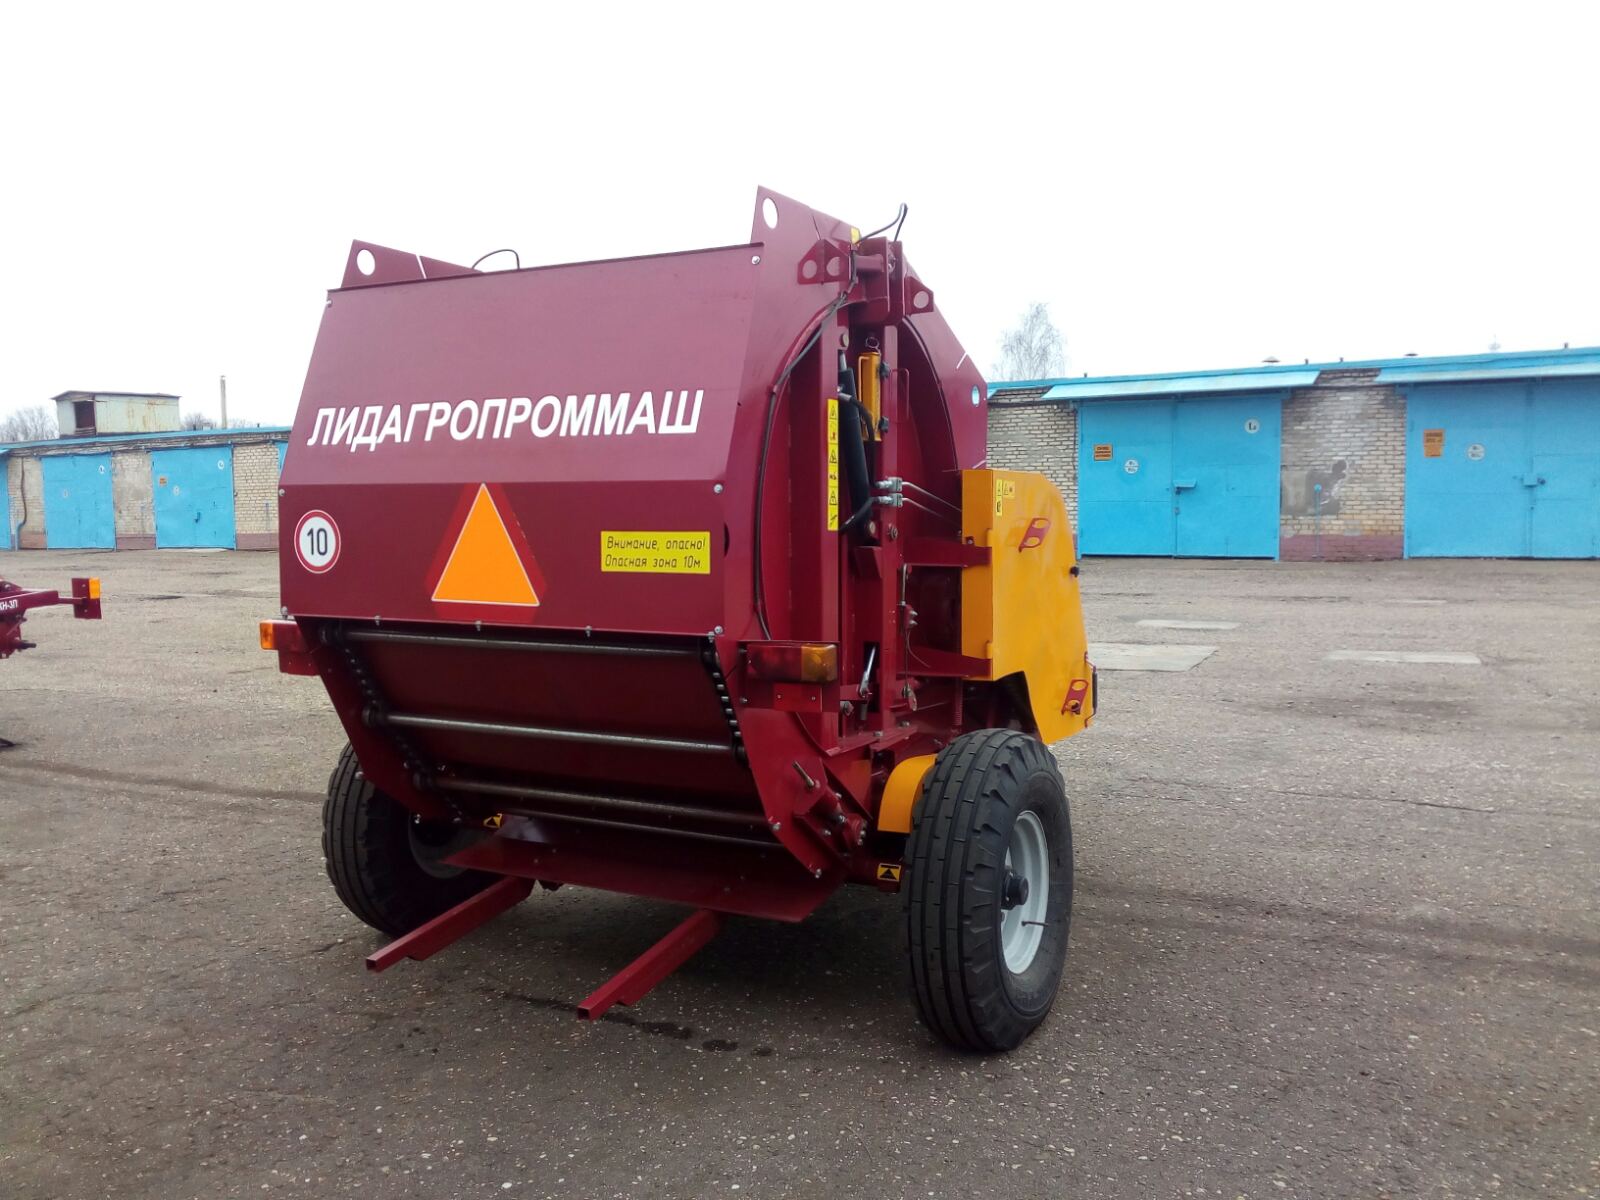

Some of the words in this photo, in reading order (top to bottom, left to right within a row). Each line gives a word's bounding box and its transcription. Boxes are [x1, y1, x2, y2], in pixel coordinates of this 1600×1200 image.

[307, 390, 703, 451] ЛИДАГРОПРОММАШ
[307, 528, 328, 556] 10
[607, 536, 660, 551] Внимание,
[666, 536, 706, 550] опасно!
[605, 554, 648, 567] Опасная
[653, 558, 678, 568] зона
